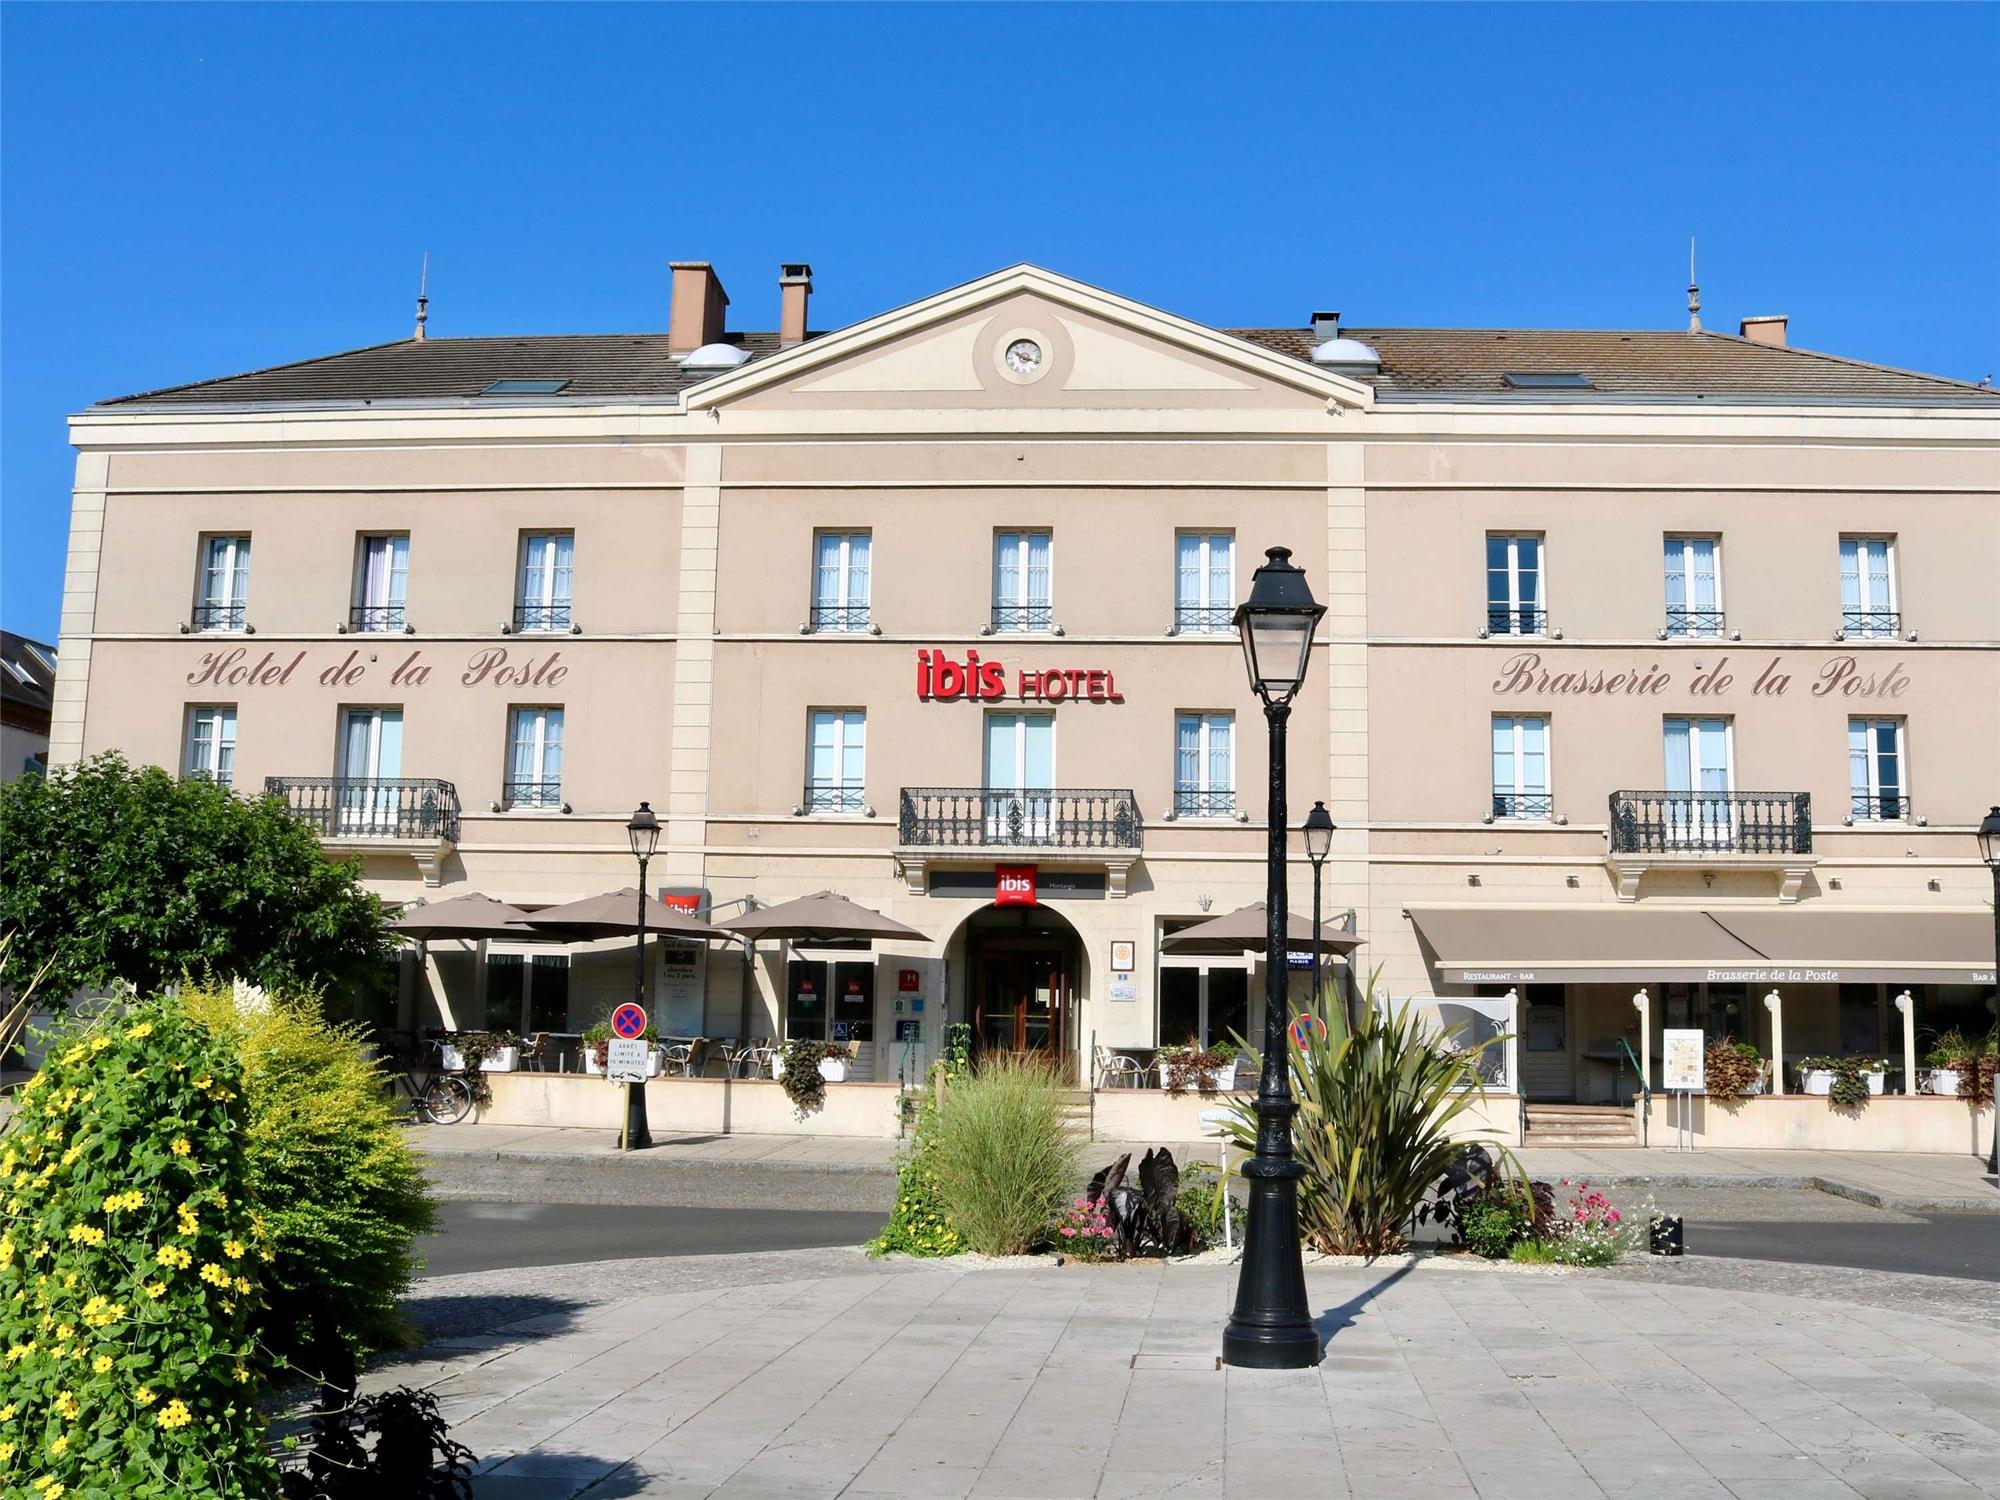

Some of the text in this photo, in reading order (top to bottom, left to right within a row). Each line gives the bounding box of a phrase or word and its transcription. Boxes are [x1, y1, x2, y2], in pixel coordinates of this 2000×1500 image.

[186, 647, 569, 688] Hotel de la Poste
[917, 649, 1122, 699] ibis HOTEL
[1492, 652, 1911, 698] Brasserie de la Poste
[1000, 874, 1031, 891] ibis
[1707, 969, 1839, 980] Brasserie de la Poste
[1972, 973, 1988, 981] BAR
